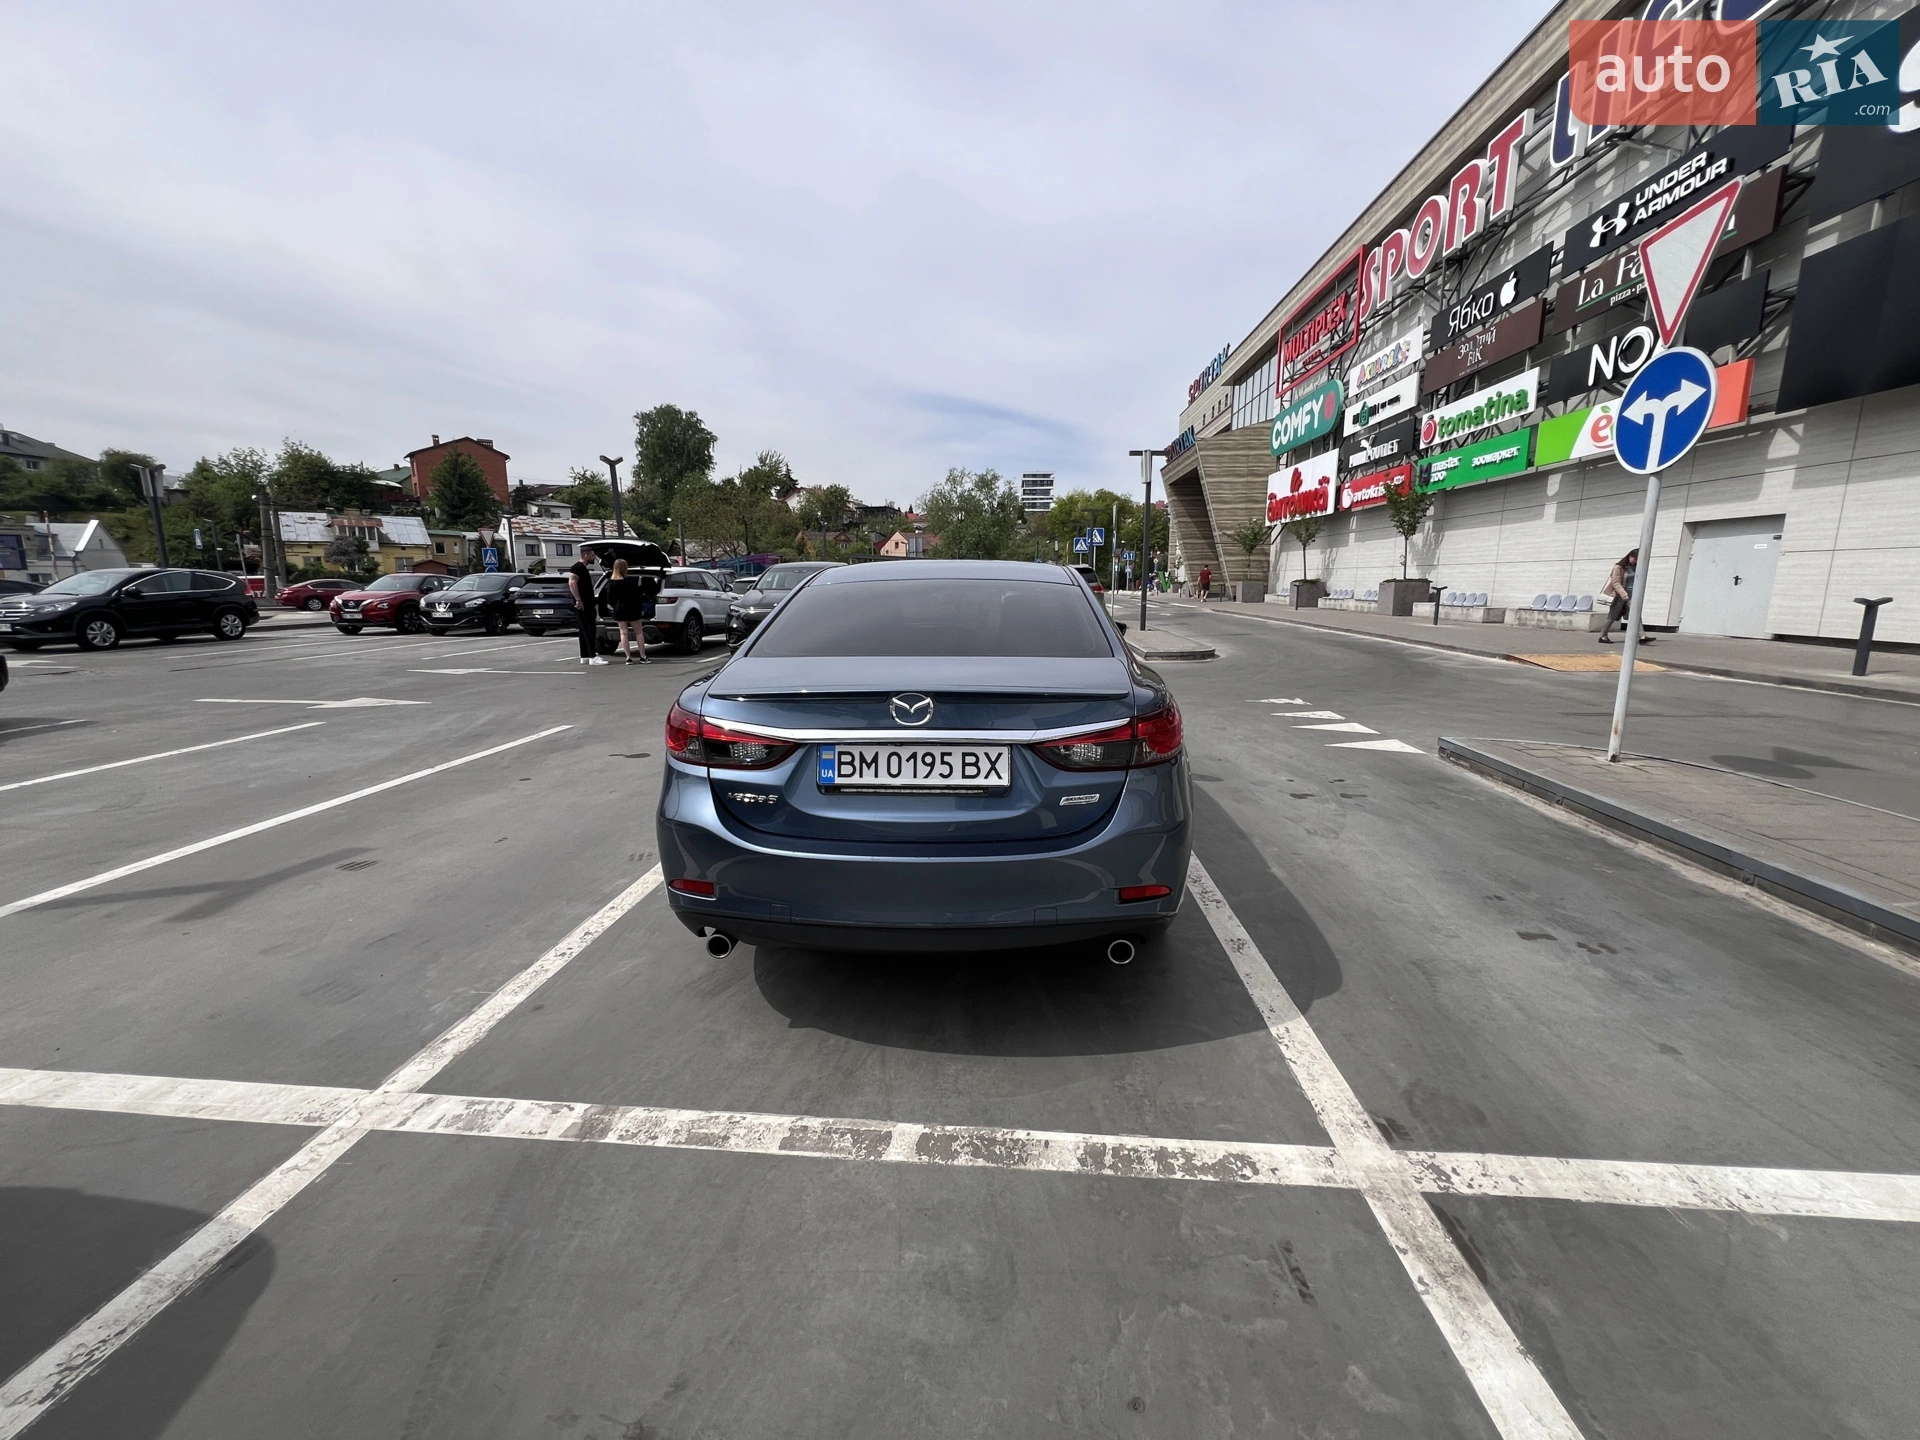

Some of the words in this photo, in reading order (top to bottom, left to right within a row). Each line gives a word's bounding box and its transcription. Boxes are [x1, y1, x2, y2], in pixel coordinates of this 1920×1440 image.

[1632, 157, 1728, 226] ARMOUR
[1635, 151, 1708, 206] UNDER
[1360, 107, 1535, 322] SPORT
[1447, 291, 1495, 338] Ябко
[1577, 277, 1604, 307] La
[1610, 287, 1632, 307] pizza
[1284, 289, 1350, 368] MULTIPLEX
[1272, 393, 1324, 450] COMFY
[1437, 388, 1529, 439] tomatina
[821, 769, 834, 778] UA
[837, 751, 879, 778] BM
[886, 751, 954, 779] 0195
[961, 752, 1004, 779] BX
